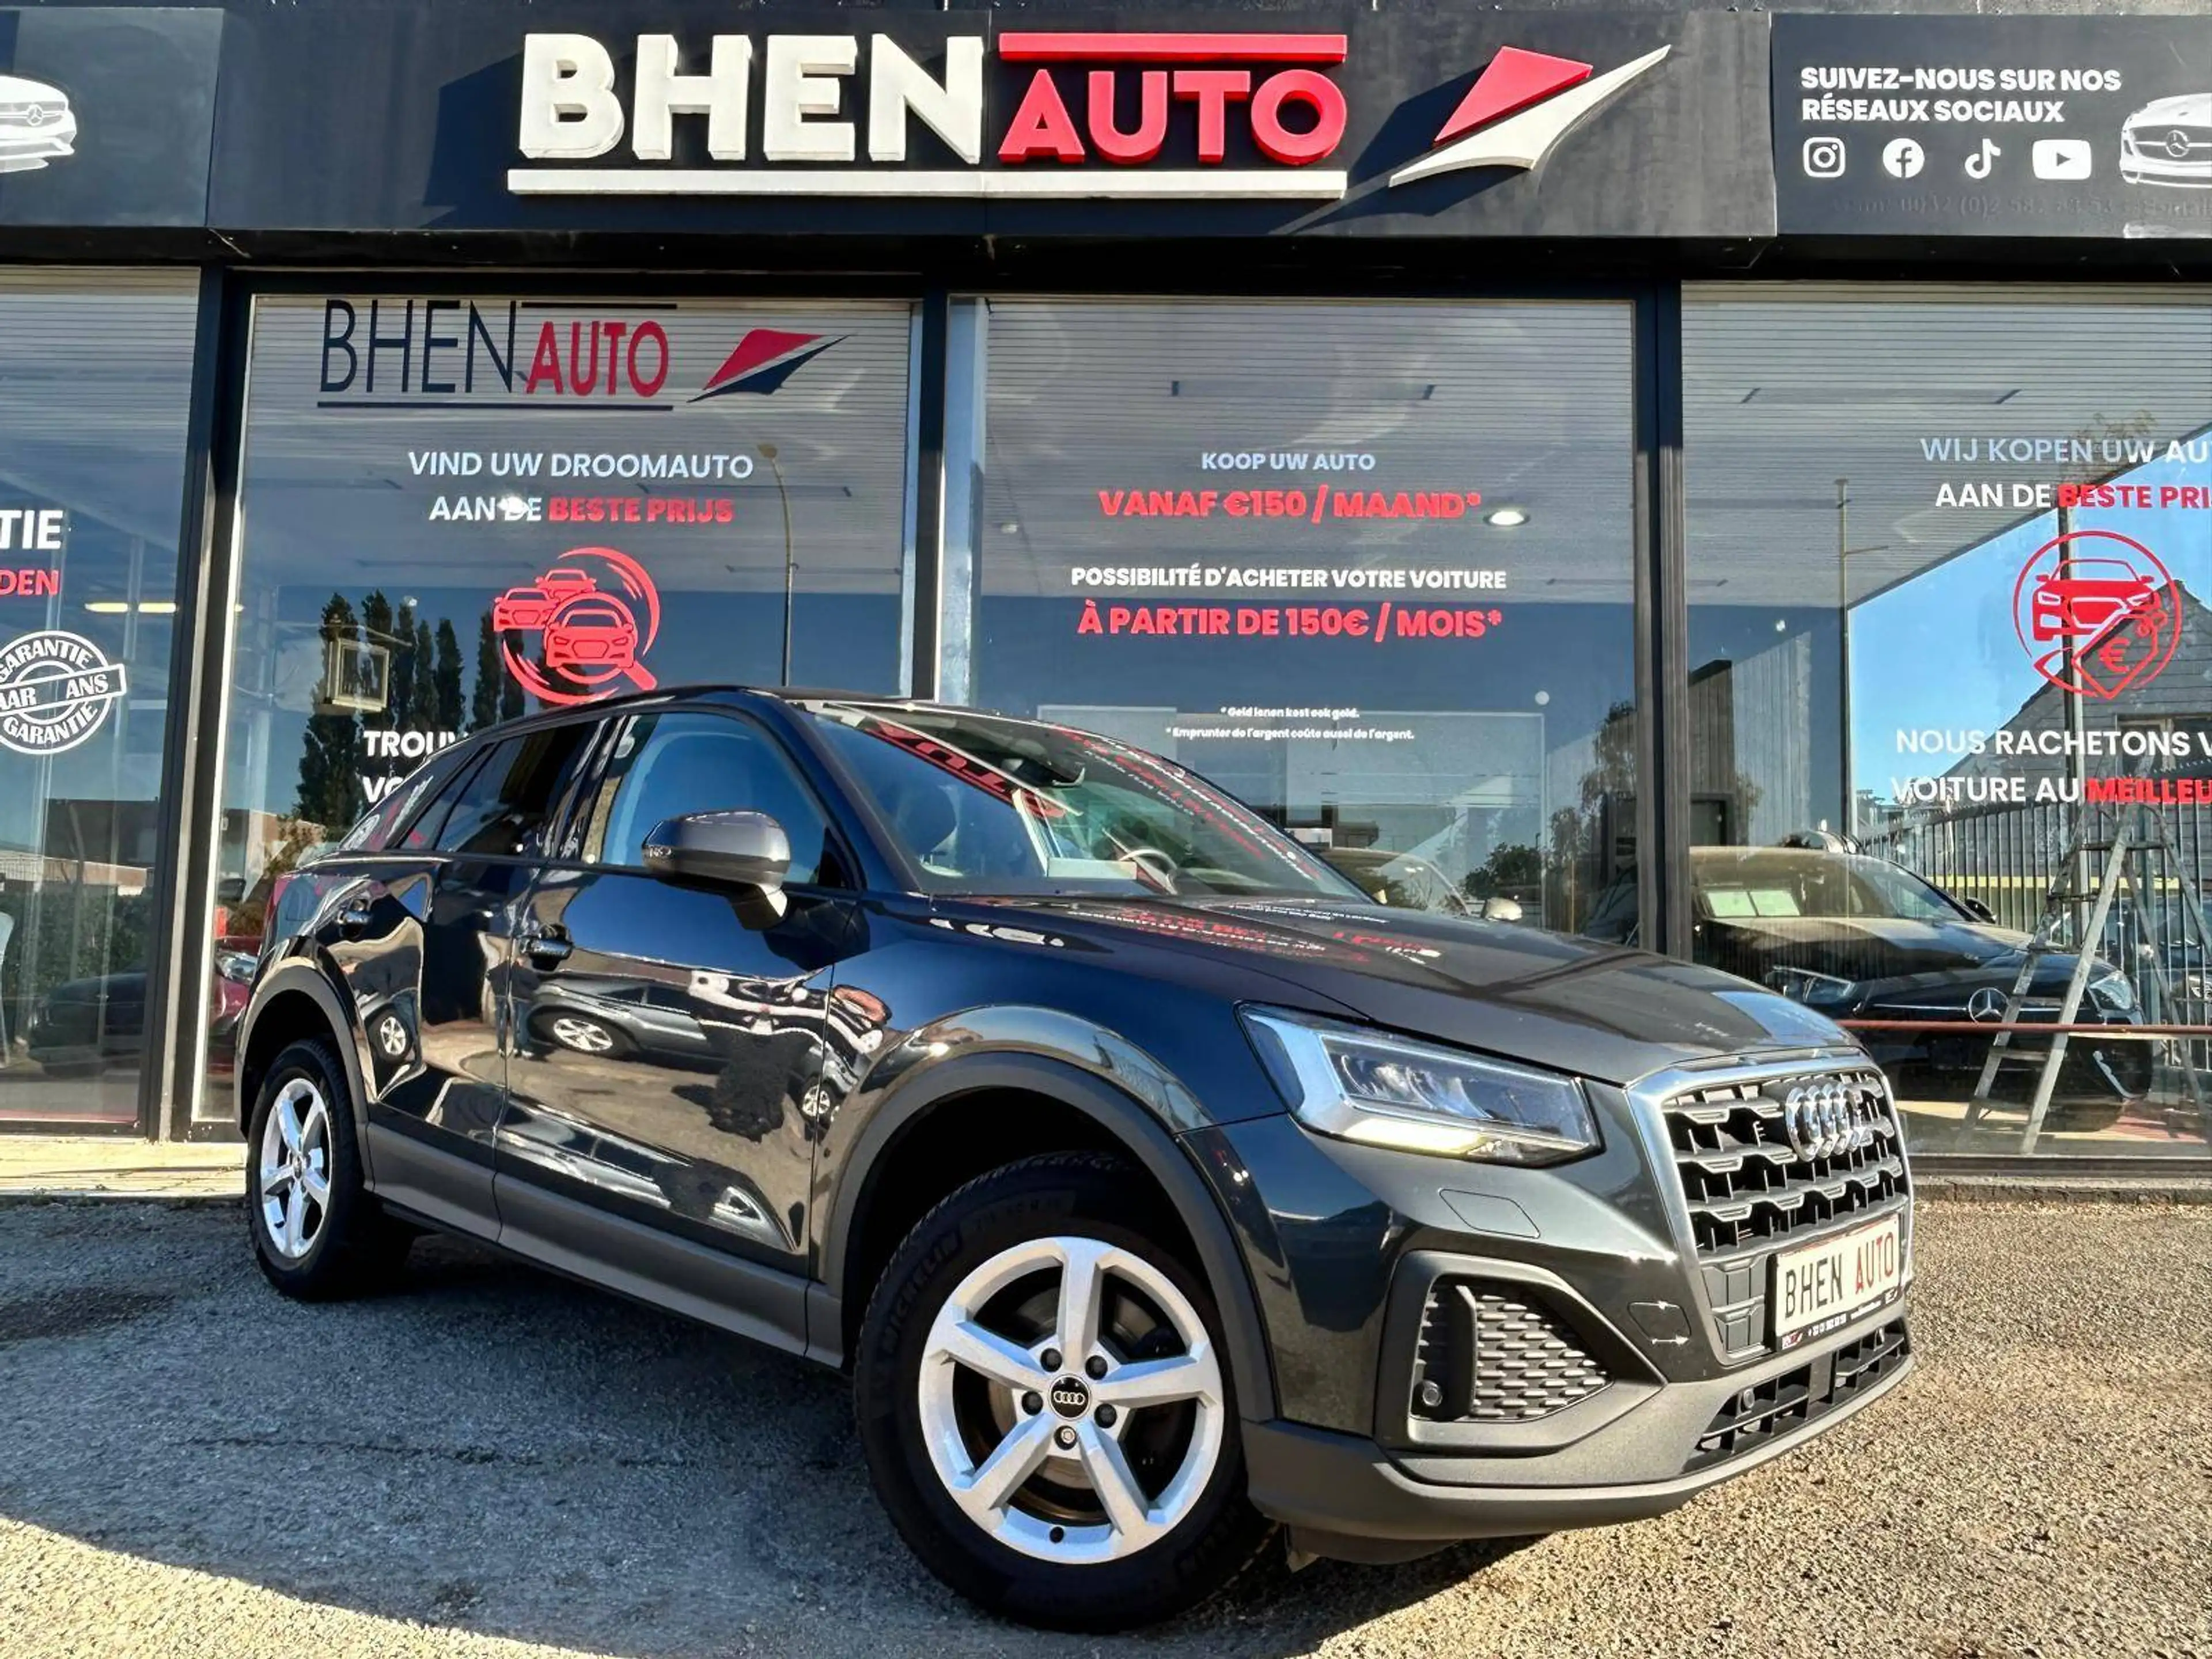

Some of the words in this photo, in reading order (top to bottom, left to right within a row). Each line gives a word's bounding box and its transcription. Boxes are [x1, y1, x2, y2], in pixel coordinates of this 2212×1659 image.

[1801, 67, 1995, 90] SUIVEZ-NOUS
[1999, 69, 2056, 91] SUR
[2061, 69, 2122, 92] NOS
[520, 33, 984, 164] BHEN
[998, 69, 1347, 165] AUTO
[1802, 93, 1930, 122] RÉSEAUX
[1933, 100, 2065, 122] SOCIAUX
[320, 299, 516, 392] BHEN
[527, 320, 669, 397] AUTO
[1202, 453, 1266, 471] KOOP
[1270, 453, 1307, 471] UW
[1313, 453, 1376, 471] AUTO
[1921, 438, 1978, 461] WIJ
[1989, 438, 2092, 462] KOPEN
[2104, 439, 2154, 463] UW
[2166, 440, 2212, 464] AU
[408, 452, 482, 476] VIND
[491, 453, 544, 476] UW
[551, 454, 753, 479] DROOMAUTO
[1100, 491, 1215, 516] VANAF
[1223, 491, 1306, 517] €150
[1936, 483, 2002, 507] AAN
[2013, 484, 2051, 507] DE
[2058, 484, 2152, 508] BESTE
[429, 497, 493, 521] AAN
[503, 497, 541, 521] DE
[548, 497, 641, 522] BESTE
[647, 498, 736, 522] PRIJS
[1071, 563, 1201, 586] POSSIBILITÉ
[1205, 566, 1328, 587] D'ACHETER
[1332, 569, 1405, 588] VOTRE
[1410, 570, 1506, 589] VOITURE
[1078, 599, 1103, 634] À
[1110, 608, 1229, 635] PARTIR
[1238, 608, 1279, 635] DE
[1285, 608, 1369, 637] 150€
[66, 675, 109, 699] ANS
[3, 702, 98, 745] GARANTIE
[1228, 706, 1253, 717] Geld
[1286, 707, 1310, 717] kost
[1172, 728, 1231, 741] Emprunter
[1232, 728, 1247, 738] de
[1323, 728, 1353, 739] aussi
[1354, 728, 1368, 739] de
[1896, 729, 1986, 755] NOUS
[1995, 730, 2191, 756] RACHETONS
[1891, 777, 2025, 803] VOITURE
[2035, 777, 2079, 803] AU
[1785, 1252, 1843, 1319] BHEN
[1855, 1232, 1893, 1295] AUTO
